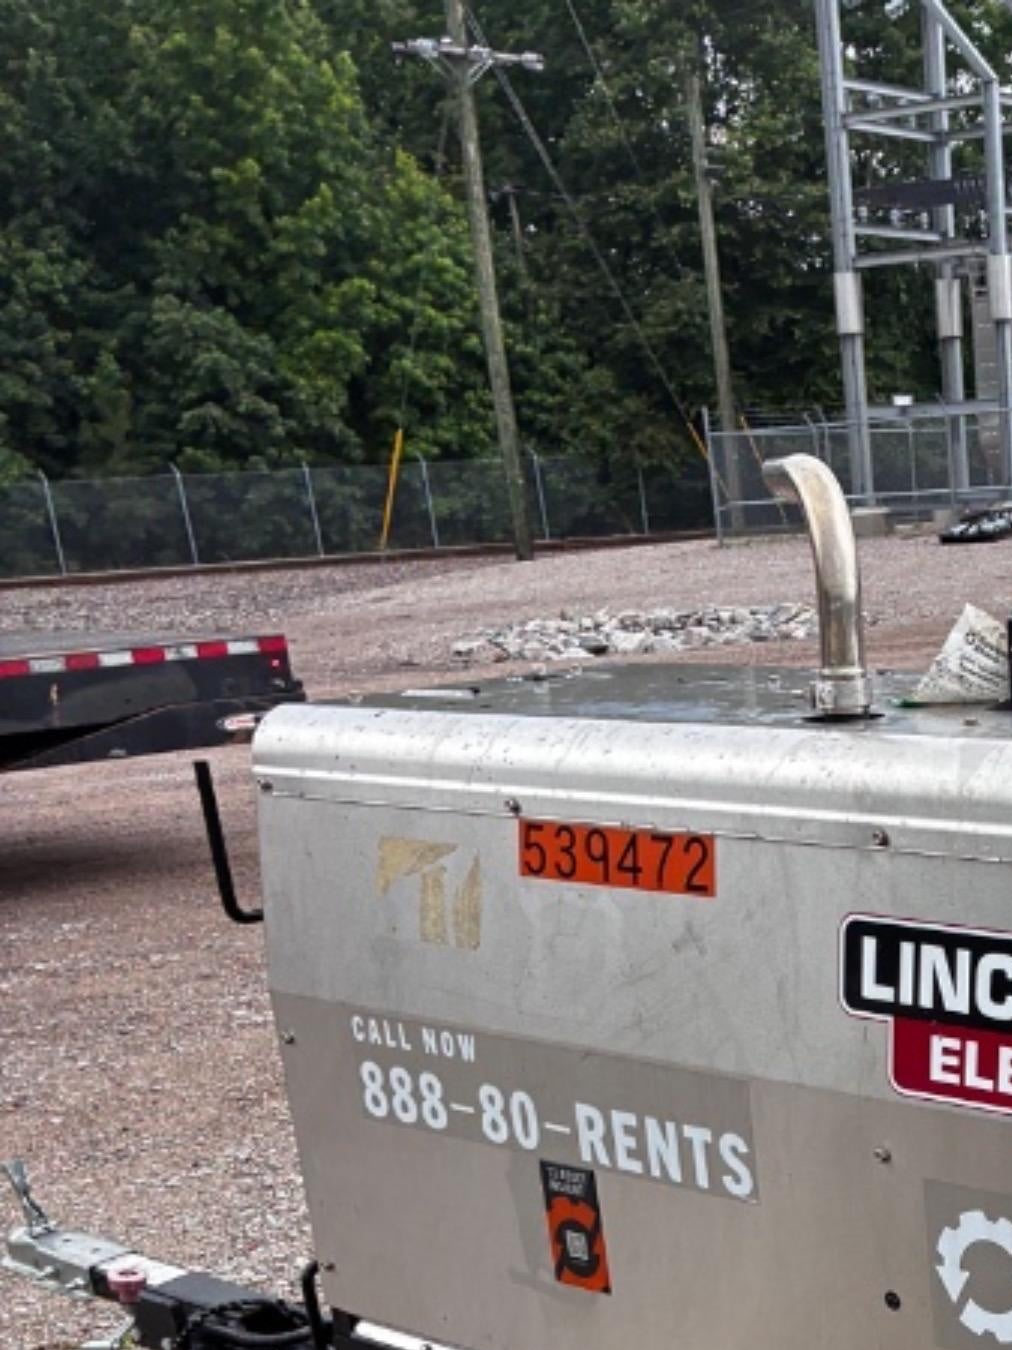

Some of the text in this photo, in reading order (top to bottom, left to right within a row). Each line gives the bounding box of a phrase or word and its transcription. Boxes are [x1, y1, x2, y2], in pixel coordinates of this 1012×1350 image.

[521, 823, 710, 893] 539472
[351, 1015, 477, 1063] CALL NOW
[359, 1060, 755, 1198] 888-80-RENTS
